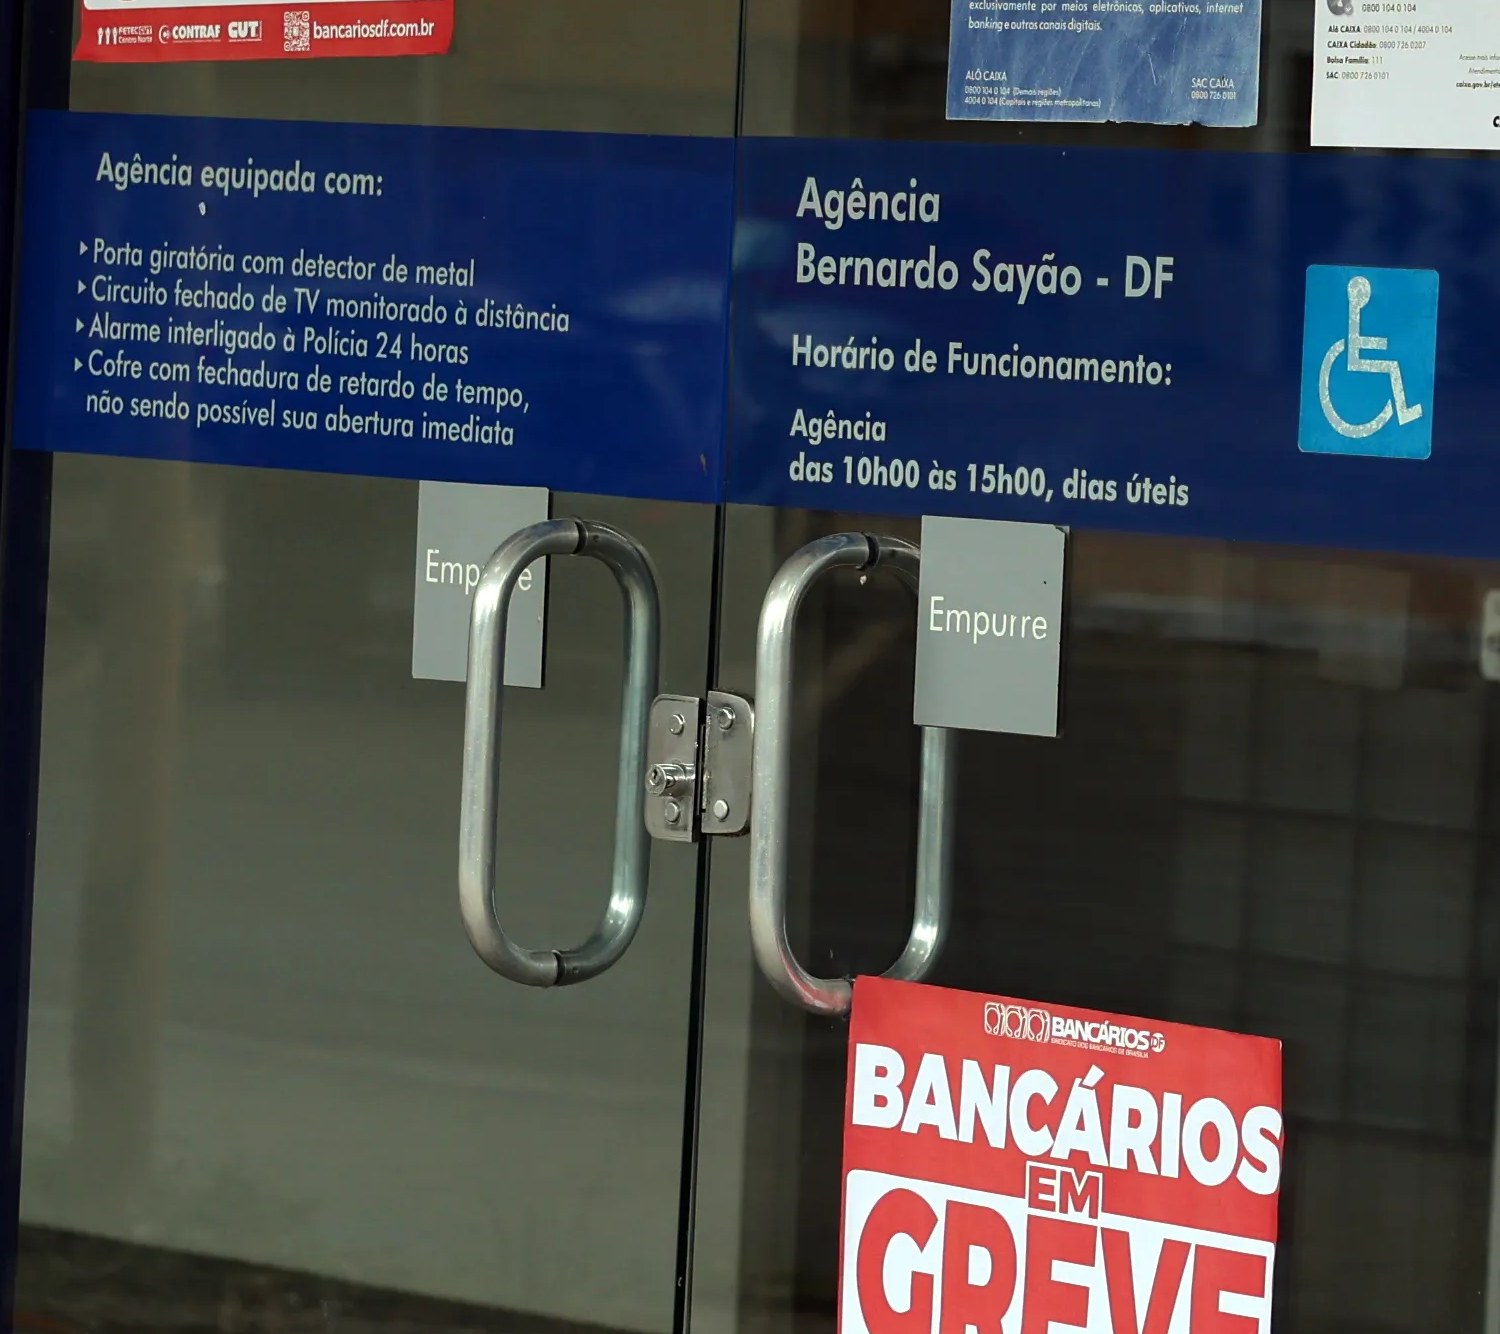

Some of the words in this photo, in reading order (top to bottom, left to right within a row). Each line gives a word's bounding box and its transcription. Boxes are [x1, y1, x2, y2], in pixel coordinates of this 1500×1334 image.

[314, 18, 434, 38] bancariosdf.com.br
[96, 153, 191, 190] Agência
[201, 158, 315, 197] equipada
[325, 173, 382, 196] com:
[796, 177, 939, 230] Agência
[94, 238, 142, 266] Porta
[150, 242, 234, 274] giratória
[243, 255, 283, 274] com
[292, 249, 376, 280] detector
[383, 254, 407, 282] de
[416, 259, 474, 286] metal
[797, 243, 958, 289] Bernardo
[972, 249, 1081, 304] Sayão
[1097, 278, 1108, 286] -
[1125, 255, 1173, 298] DF
[92, 275, 167, 305] Circuito
[175, 279, 254, 311] fechado
[262, 285, 286, 313] de
[294, 288, 320, 314] TV
[327, 293, 447, 323] monitorado
[455, 300, 467, 325] à
[476, 299, 568, 331] distância
[89, 312, 160, 342] Alarme
[168, 317, 276, 354] interligado
[283, 327, 295, 351] à
[304, 327, 367, 356] Polícia
[376, 332, 402, 359] 24
[411, 333, 468, 364] horas
[793, 334, 894, 370] Horário
[905, 340, 937, 373] de
[948, 342, 1171, 385] Funcionamento:
[89, 349, 142, 378] Cofre
[149, 362, 189, 381] com
[197, 356, 298, 390] fechadura
[307, 364, 331, 392] de
[340, 370, 414, 398] retardo
[423, 373, 448, 401] de
[456, 379, 528, 413] tempo,
[87, 390, 123, 414] não
[131, 392, 189, 419] sendo
[197, 399, 275, 427] possível
[282, 410, 317, 429] sua
[326, 404, 413, 437] abertura
[423, 412, 513, 445] imediata
[790, 409, 885, 445] Agência
[790, 452, 833, 482] das
[844, 456, 919, 488] 10h00
[929, 460, 956, 490] às
[967, 464, 1053, 502] 15h00,
[1063, 469, 1117, 501] dias
[1127, 473, 1188, 506] úteis
[426, 549, 532, 595] Empe
[929, 596, 1048, 644] Empurre
[1052, 1016, 1150, 1051] BANCÁRIOS
[852, 1065, 1283, 1195] BANCÁRIOS
[1027, 1160, 1102, 1219] EM
